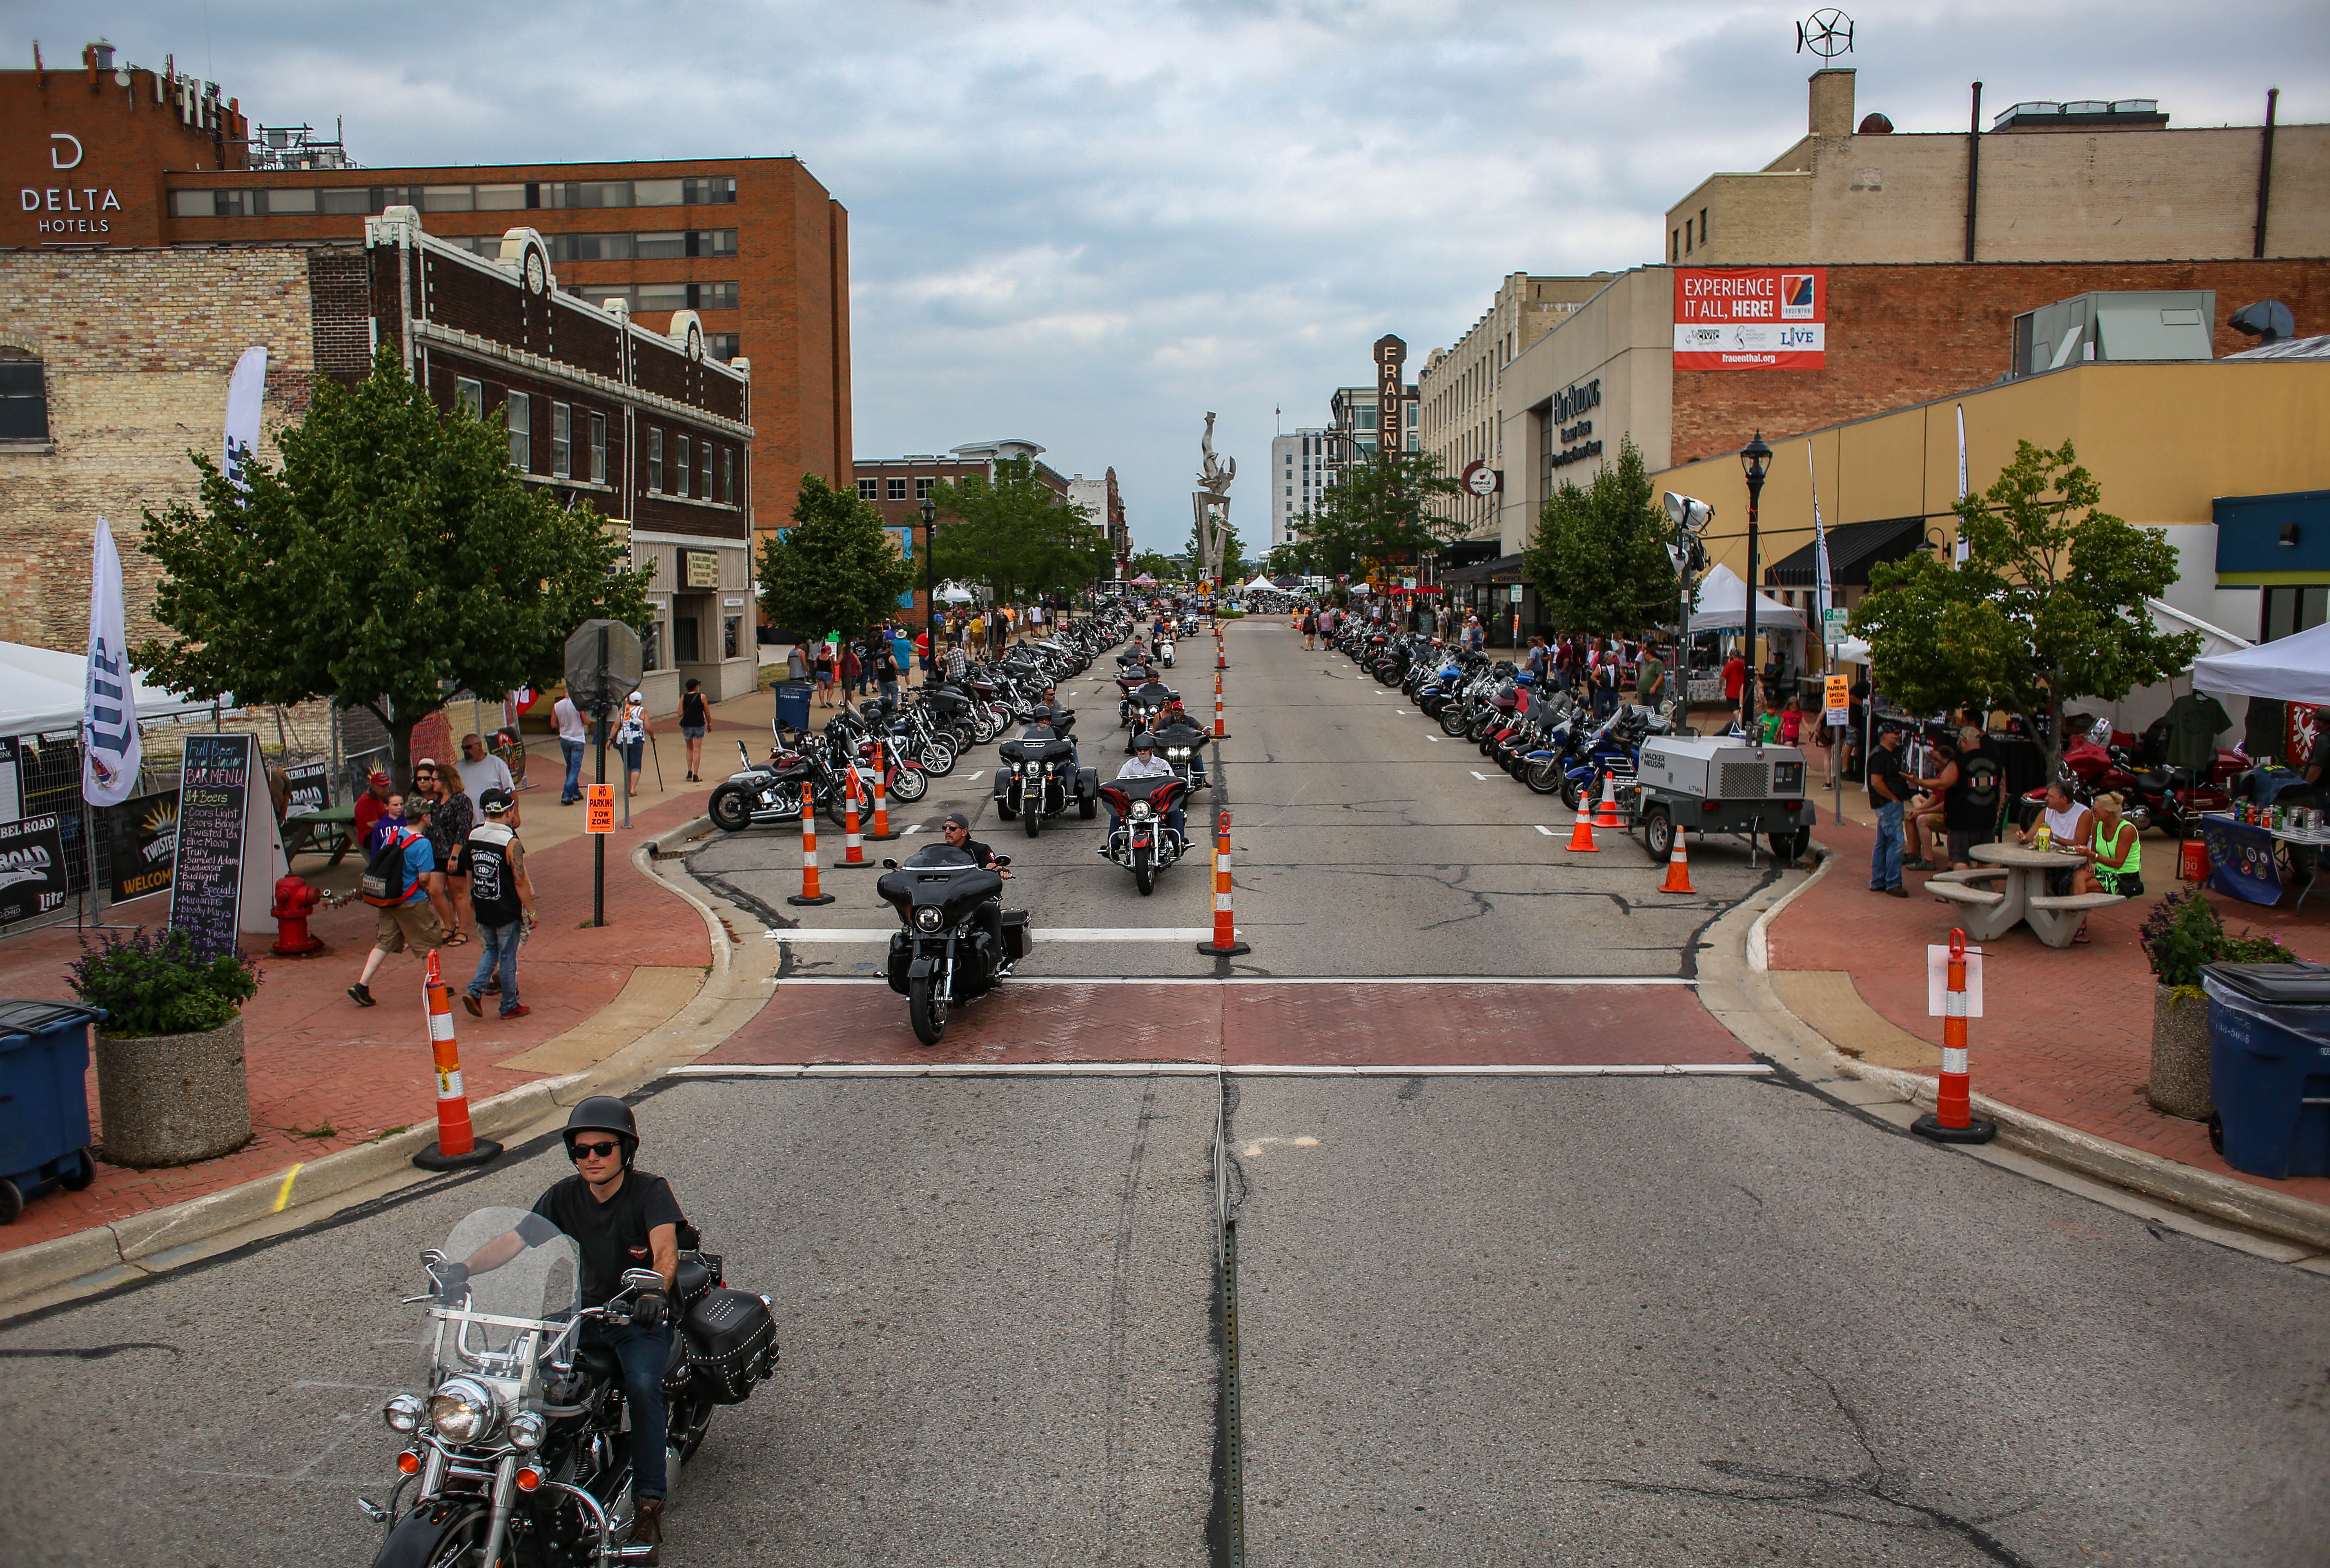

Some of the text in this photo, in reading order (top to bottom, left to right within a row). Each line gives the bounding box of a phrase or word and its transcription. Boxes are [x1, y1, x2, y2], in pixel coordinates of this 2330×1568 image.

[21, 189, 121, 211] DELTA
[39, 219, 109, 232] HOTELS
[1684, 278, 1774, 296] EXPERIENCE
[1684, 300, 1774, 320] IT ALL, HERE!
[1780, 327, 1813, 347] LIVE
[1722, 353, 1775, 364] frauenthal.org
[1384, 346, 1397, 513] FRAUENT
[1827, 610, 1832, 619] 2
[189, 740, 237, 757] Full Beer
[188, 756, 244, 771] and Liquor
[1644, 752, 1665, 762] WACKER
[1644, 759, 1665, 769] NEUSON
[186, 768, 244, 784] BAR MENU
[286, 765, 324, 781] REBEL ROAD
[185, 789, 228, 803] $4 Beers
[291, 786, 323, 804] ROAD
[598, 788, 606, 797] NO
[589, 799, 613, 807] PARKING
[189, 807, 239, 822] Coors Light
[0, 817, 55, 838] BEL ROAD
[188, 817, 243, 831] Coors Banquet
[187, 827, 222, 837] Twisted
[225, 828, 238, 839] Tea
[187, 837, 228, 849] Blue Moon
[0, 845, 51, 871] ROAD
[185, 846, 208, 858] Truly
[187, 855, 239, 866] Samuel Adams
[2185, 861, 2197, 870] DO
[123, 868, 173, 894] WELCOM
[182, 881, 196, 891] PBR
[203, 881, 236, 896] Specials
[39, 891, 64, 911] Lite
[182, 895, 223, 909] Margaritas
[4, 908, 20, 917] CHILD
[181, 905, 206, 918] Bloody
[207, 906, 232, 919] Marys
